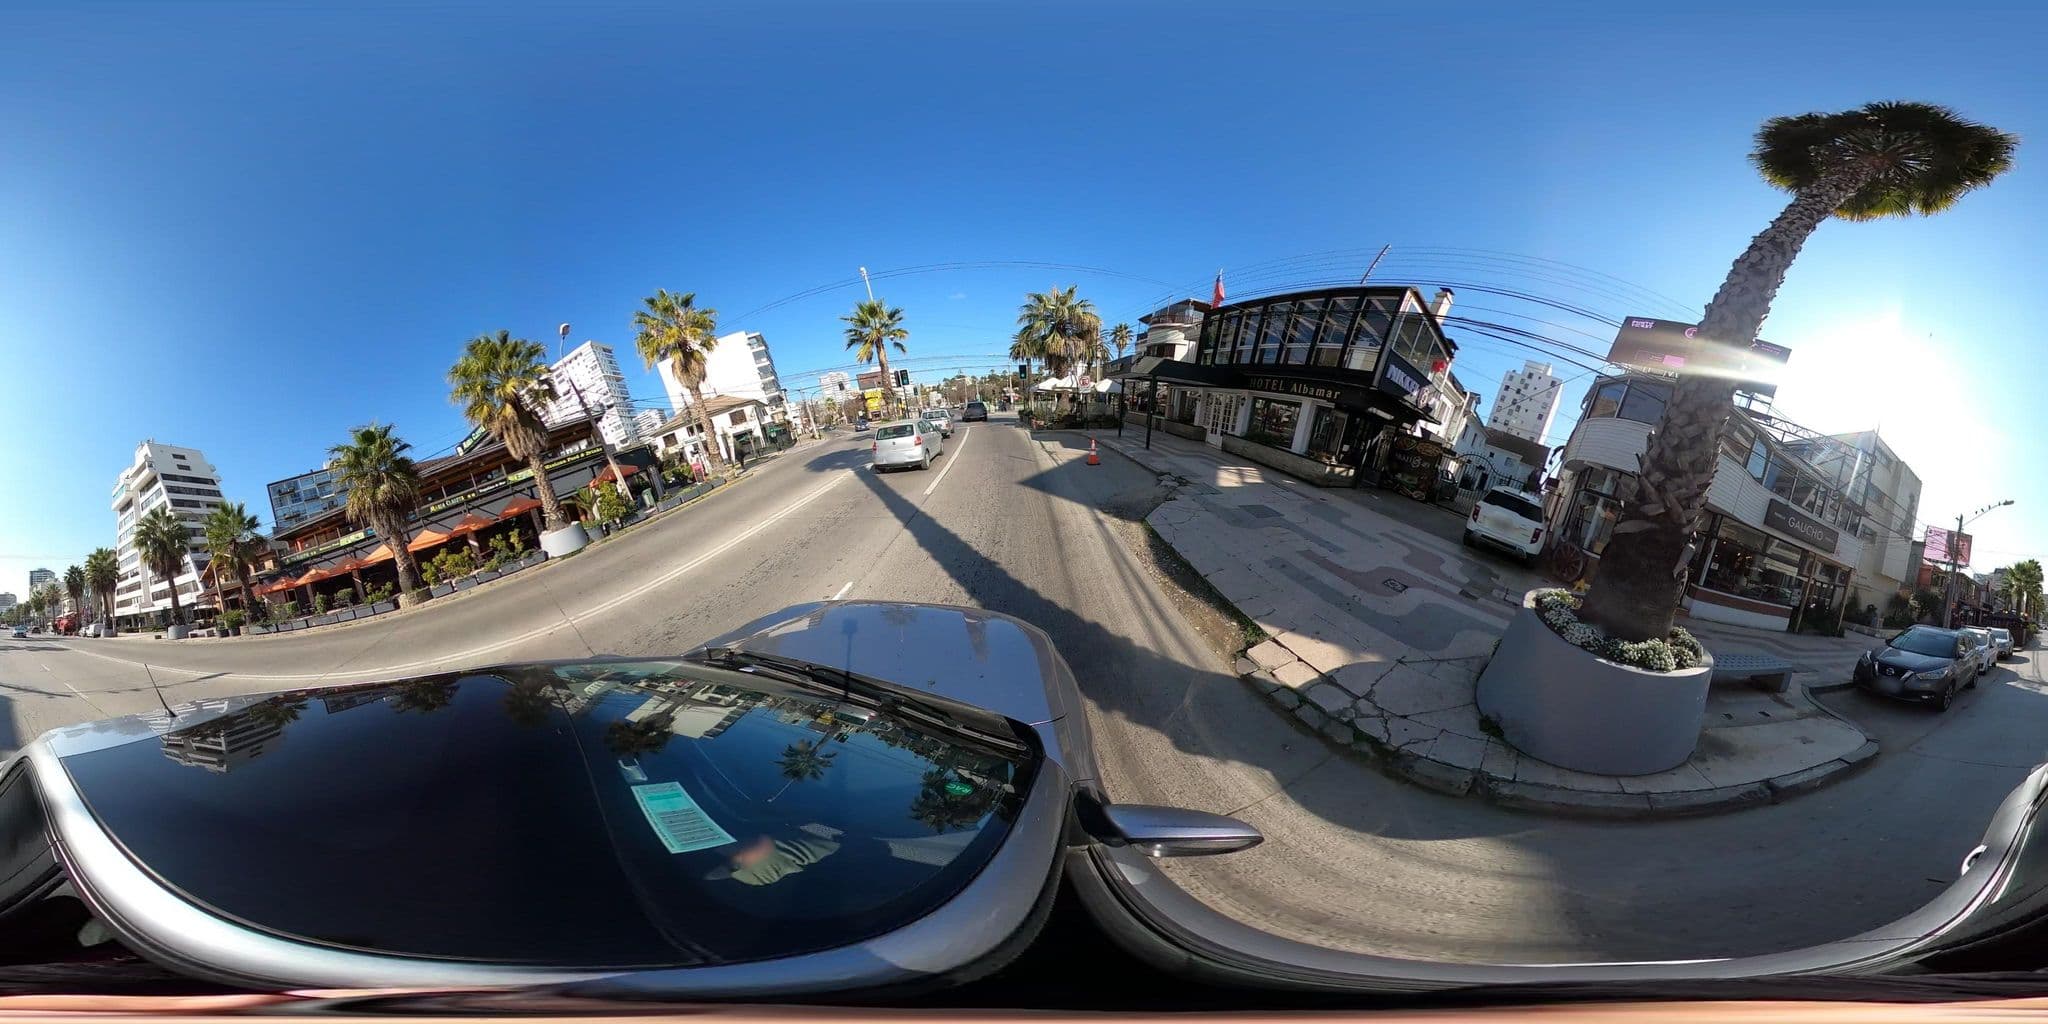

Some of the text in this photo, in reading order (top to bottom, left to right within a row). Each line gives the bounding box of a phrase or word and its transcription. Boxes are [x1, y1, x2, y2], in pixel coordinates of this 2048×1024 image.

[1250, 378, 1341, 399] HOTEL Albamar
[1788, 517, 1824, 541] GAUCHO
